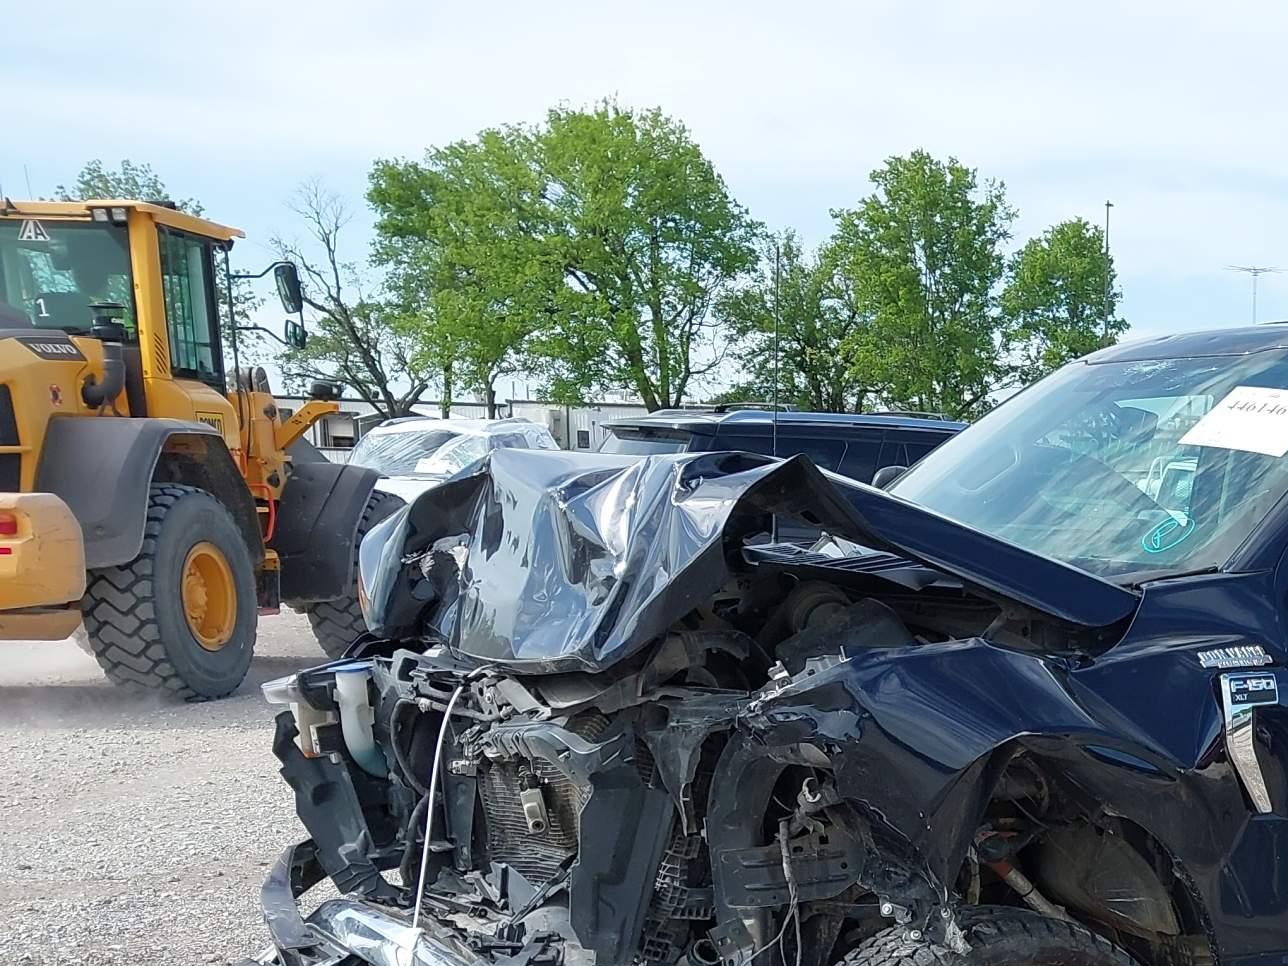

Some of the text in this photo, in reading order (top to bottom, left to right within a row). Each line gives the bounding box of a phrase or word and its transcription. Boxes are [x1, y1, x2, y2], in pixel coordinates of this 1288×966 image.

[36, 298, 50, 316] 1
[28, 343, 77, 354] VOLVO
[1230, 679, 1275, 692] F-150
[1234, 693, 1248, 701] XLT
